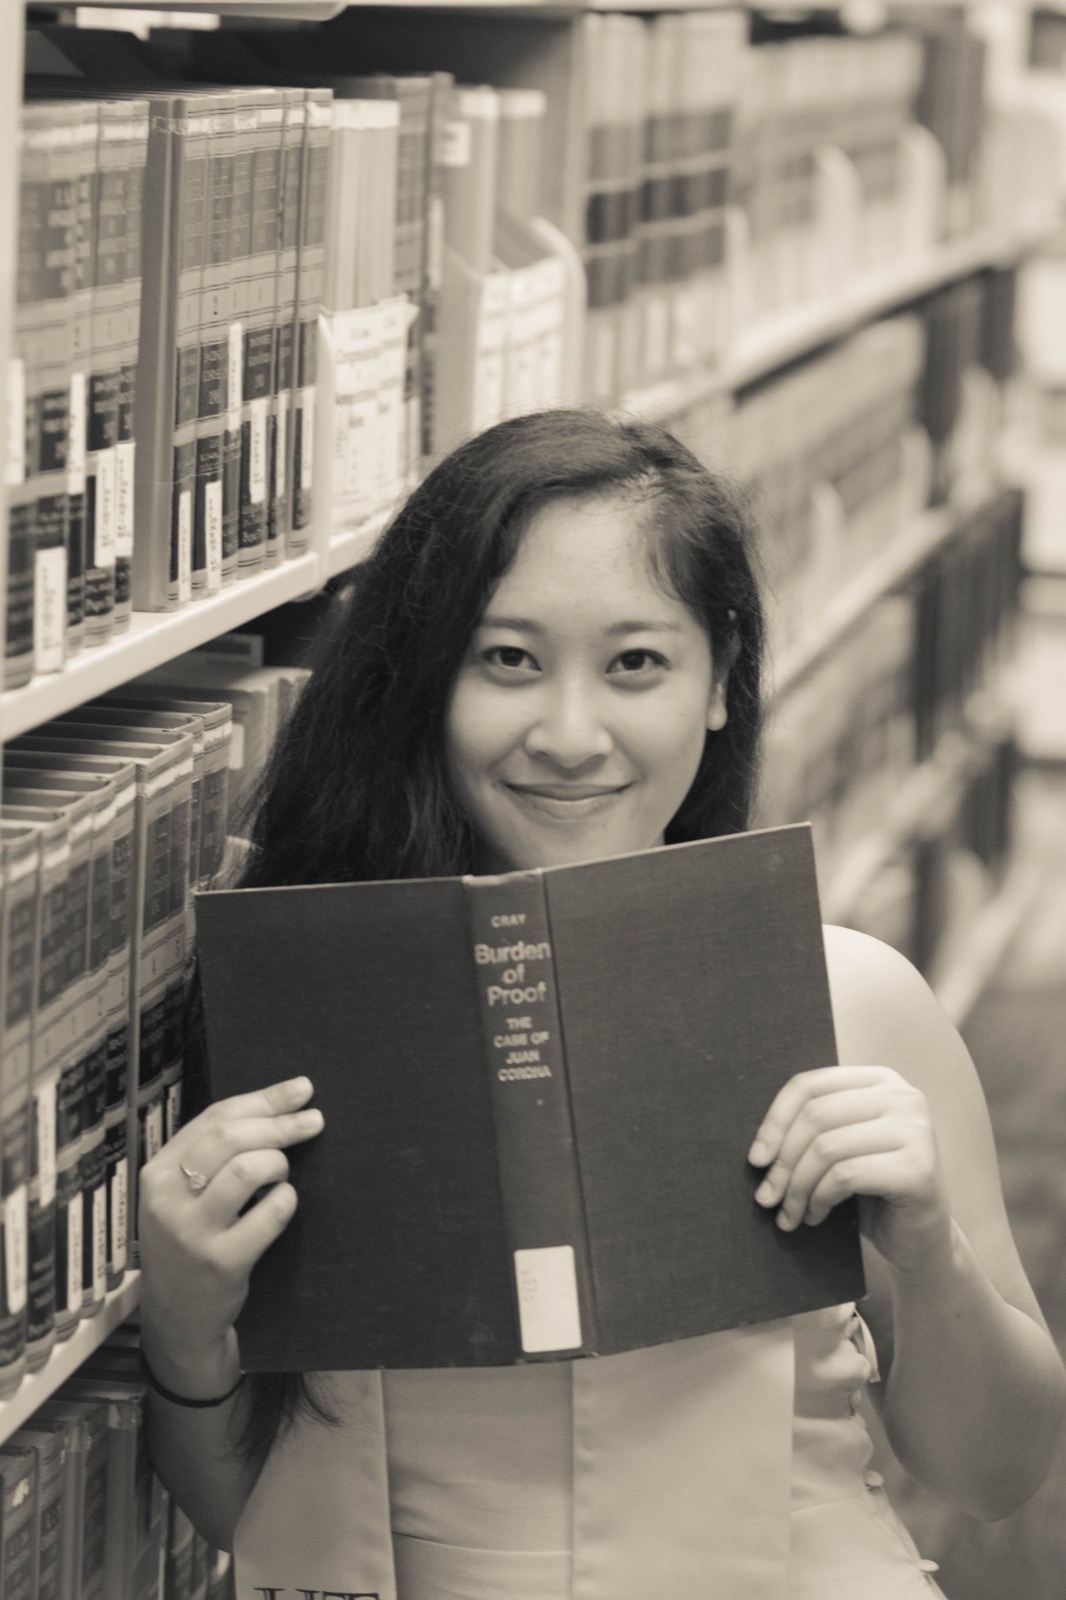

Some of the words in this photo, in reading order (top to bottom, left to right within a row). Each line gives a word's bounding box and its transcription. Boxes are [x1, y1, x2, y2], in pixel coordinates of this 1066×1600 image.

[474, 940, 551, 964] Burden
[502, 962, 525, 985] of
[487, 981, 547, 1006] Proof
[506, 1016, 532, 1030] THE
[493, 1033, 528, 1048] CASE
[530, 1031, 550, 1045] OF
[505, 1049, 540, 1064] JUAN
[497, 1065, 552, 1081] CORONA
